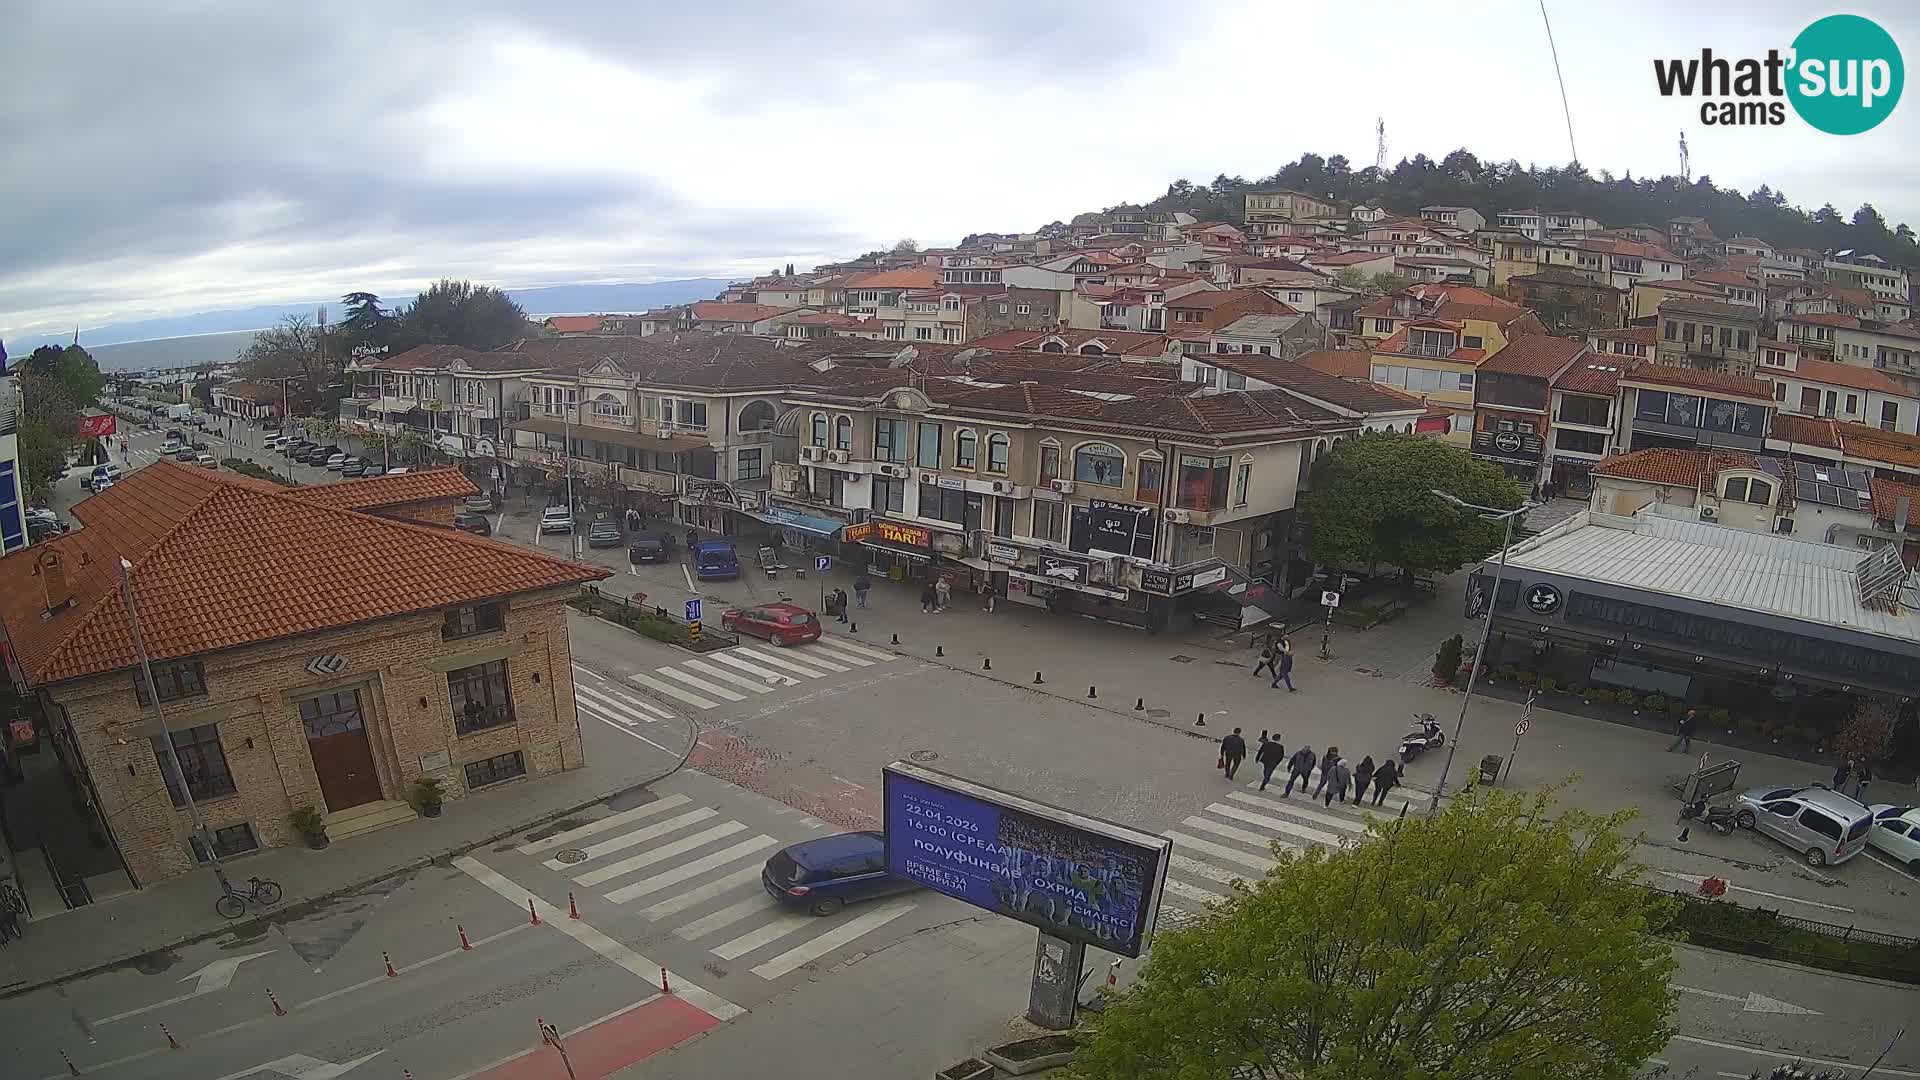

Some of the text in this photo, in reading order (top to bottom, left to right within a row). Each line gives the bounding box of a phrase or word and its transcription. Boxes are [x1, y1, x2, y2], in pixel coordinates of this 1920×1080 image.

[851, 526, 871, 537] HARI
[884, 529, 916, 545] HARI
[819, 558, 827, 569] P
[905, 803, 979, 832] 22.04.2026
[906, 818, 1012, 858] 16:00 (СРЕДА)
[913, 838, 1022, 879] полуфинале
[906, 859, 941, 876] ВРЕМЕ
[944, 870, 952, 880] Е
[953, 875, 967, 886] ЗА
[906, 867, 967, 893] ИСТОРИЈА!
[1034, 878, 1087, 903] ОХРИД
[1073, 905, 1130, 928] СИЛЕКС
